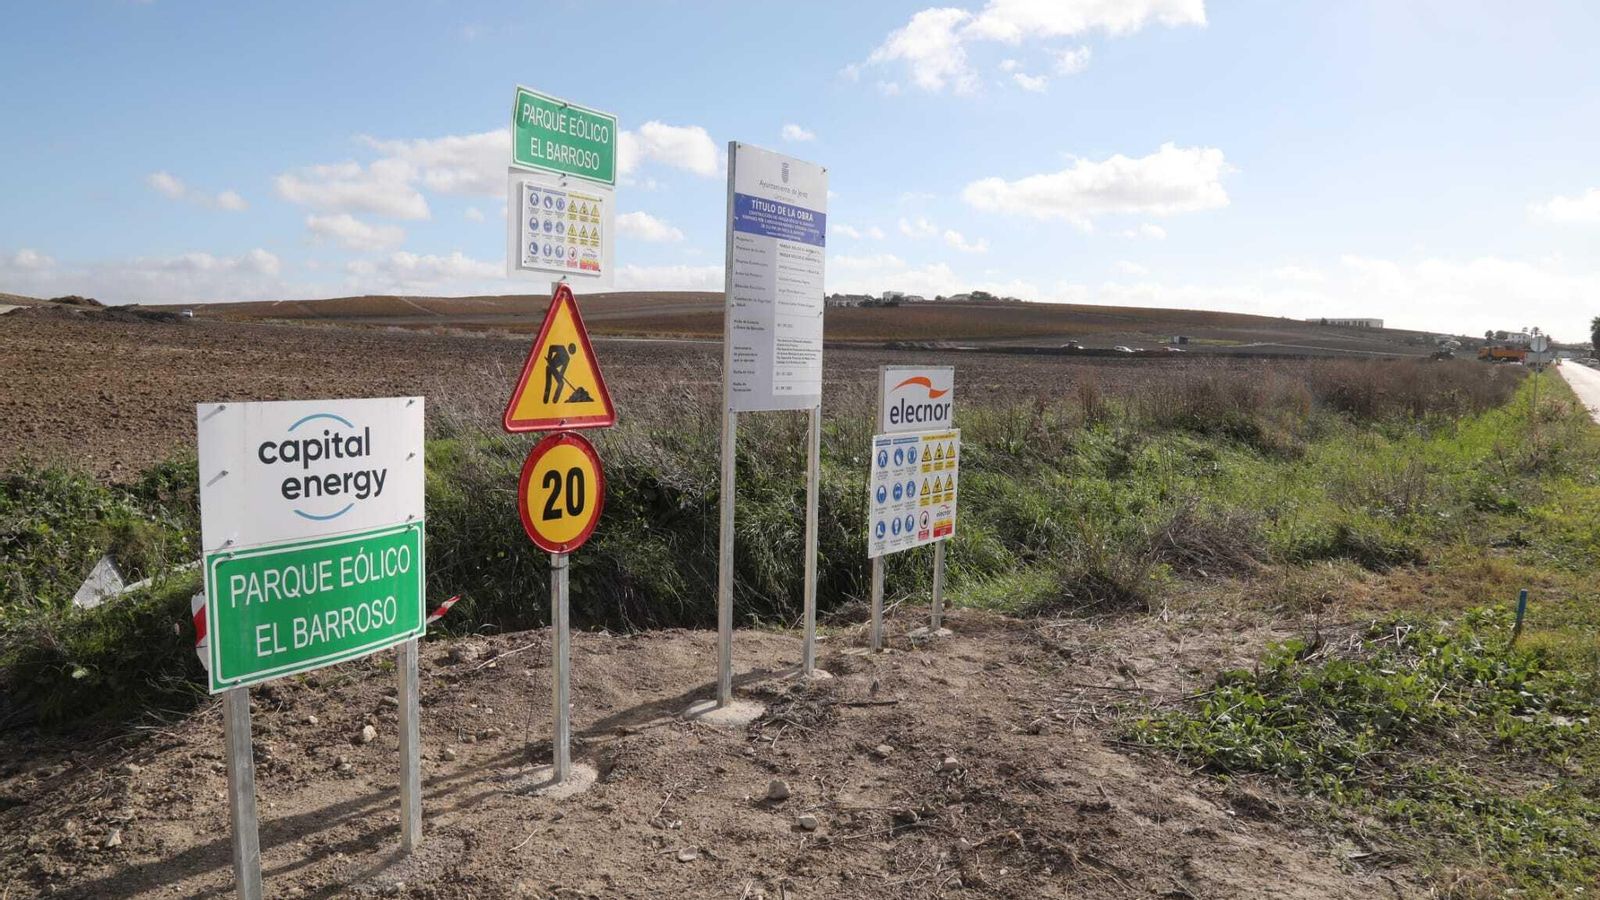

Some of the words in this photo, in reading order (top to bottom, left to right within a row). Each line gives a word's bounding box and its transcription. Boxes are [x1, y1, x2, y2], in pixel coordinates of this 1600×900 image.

[522, 103, 567, 133] PARQUE
[569, 116, 609, 144] EÓLICO
[530, 137, 544, 158] EL
[546, 141, 600, 170] BARROSO
[752, 199, 776, 213] TÍTULO
[777, 204, 786, 216] DE
[787, 207, 796, 218] LA
[796, 211, 814, 222] OBRA
[890, 398, 951, 425] elecnor
[258, 426, 370, 469] capital
[281, 468, 387, 500] energy
[542, 467, 585, 520] 20
[230, 560, 333, 608] PARQUE
[340, 547, 411, 587] EÓLICO
[256, 622, 287, 658] EL
[293, 596, 397, 649] BARROSO
